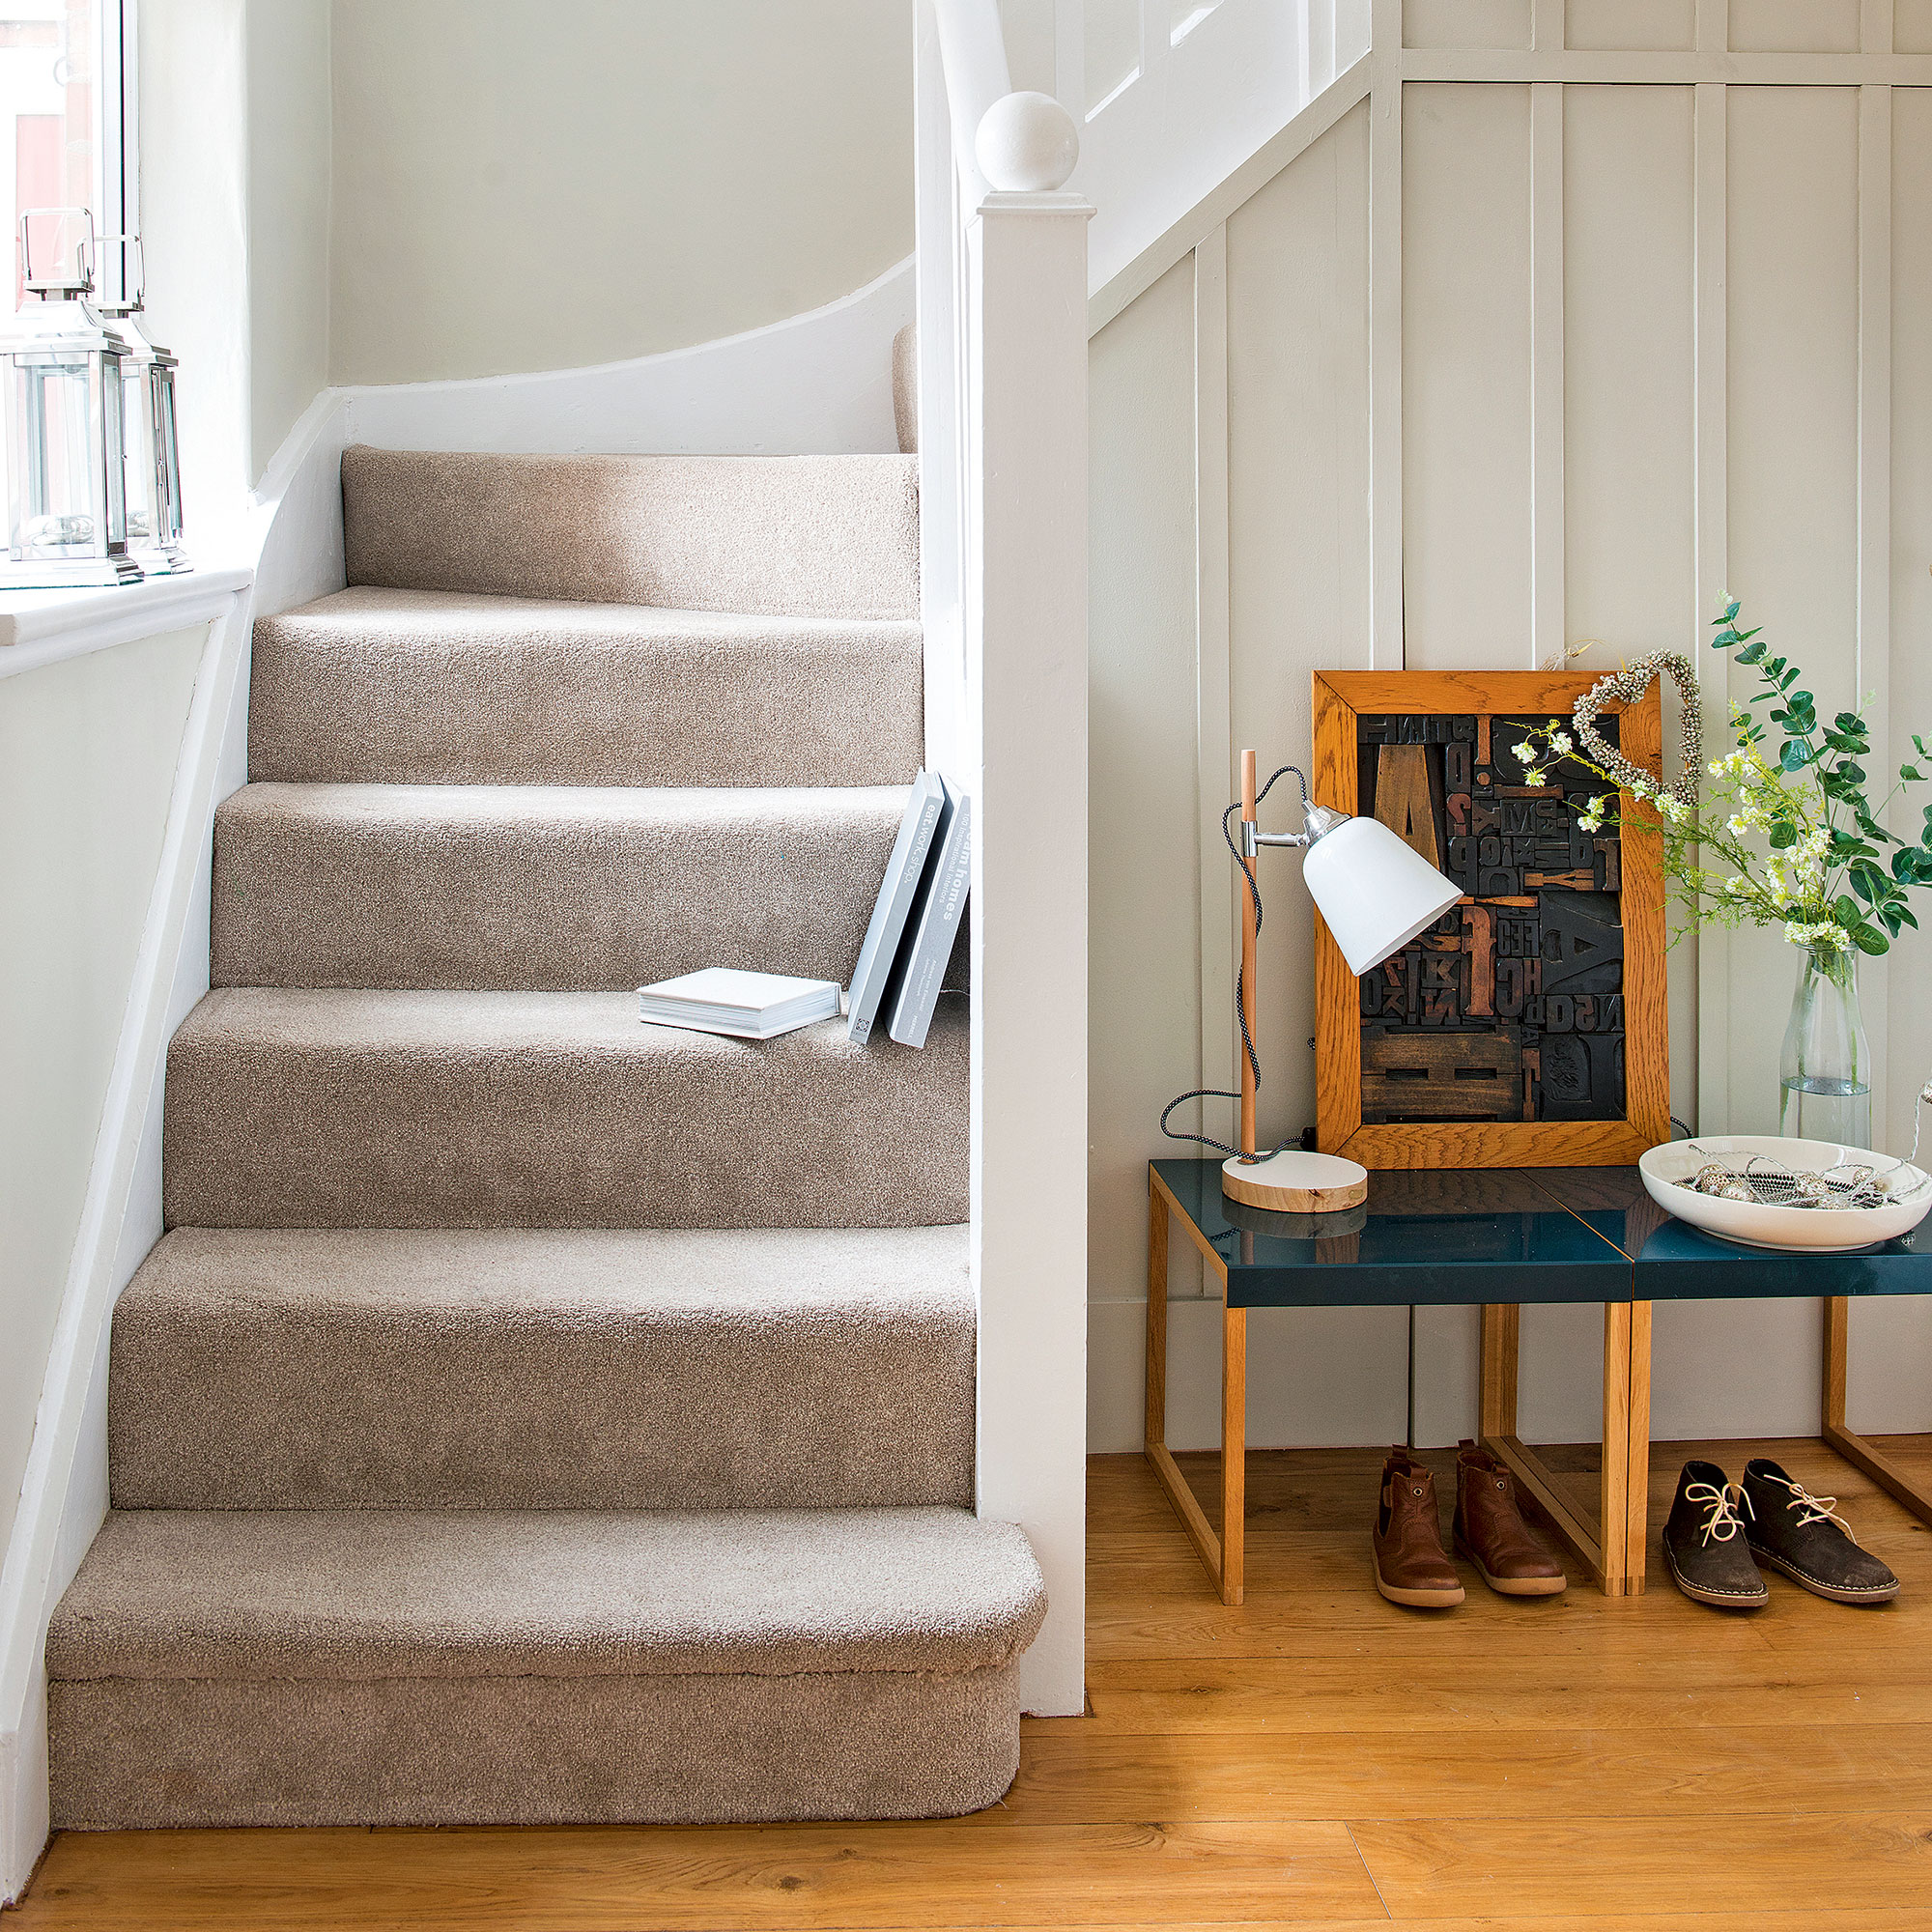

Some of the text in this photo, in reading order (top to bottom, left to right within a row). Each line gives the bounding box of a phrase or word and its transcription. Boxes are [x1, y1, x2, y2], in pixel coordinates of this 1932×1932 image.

[904, 805, 936, 884] eat.work.shop.
[1374, 745, 1439, 873] A
[939, 813, 970, 903] 100 inspirational interiors
[944, 868, 968, 921] homes
[908, 1015, 918, 1038] MERRELL
